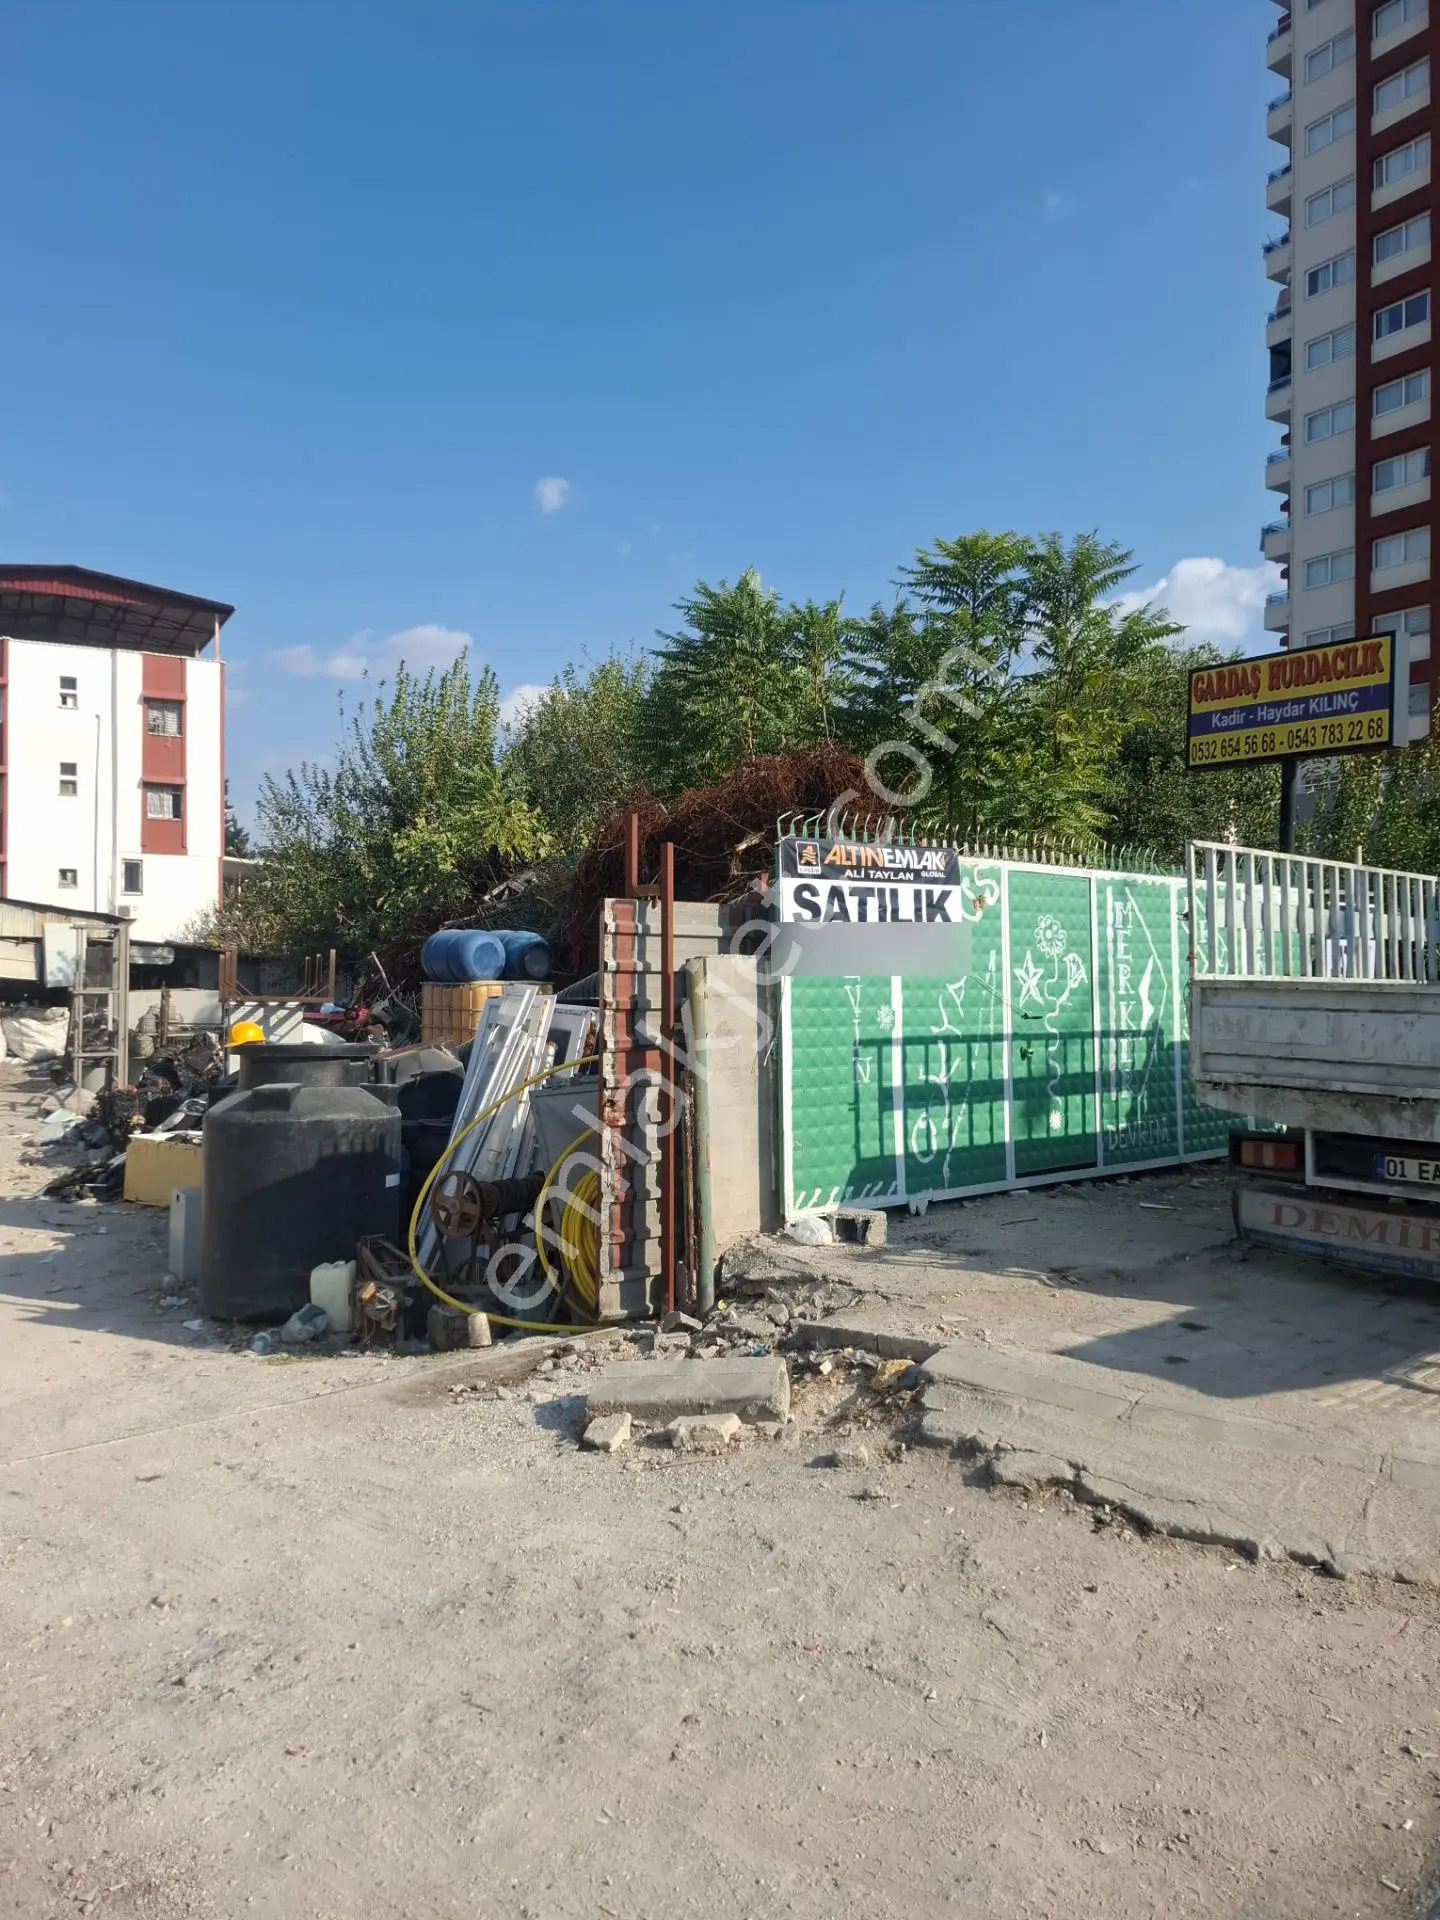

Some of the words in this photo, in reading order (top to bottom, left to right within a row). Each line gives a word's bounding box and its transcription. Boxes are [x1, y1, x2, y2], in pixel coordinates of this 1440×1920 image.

[1193, 663, 1261, 703] GARDAŞ
[1268, 641, 1384, 691] HURDACILIK
[1212, 710, 1245, 728] Kadir
[1257, 703, 1305, 723] Haydar
[1309, 692, 1359, 712] KILINÇ
[1191, 740, 1217, 762] 0532
[1220, 737, 1240, 757] 654
[1244, 735, 1258, 754] 56
[1261, 732, 1275, 752] 68
[1287, 726, 1316, 749] 0543
[1321, 723, 1343, 744] 783
[1348, 719, 1363, 742] 22
[1368, 717, 1384, 738] 68
[844, 868, 865, 879] ALİ
[869, 870, 914, 881] TAYLAN
[921, 871, 946, 879] GLOBAL
[793, 883, 954, 922] SATILIK
[1386, 1158, 1407, 1178] 01
